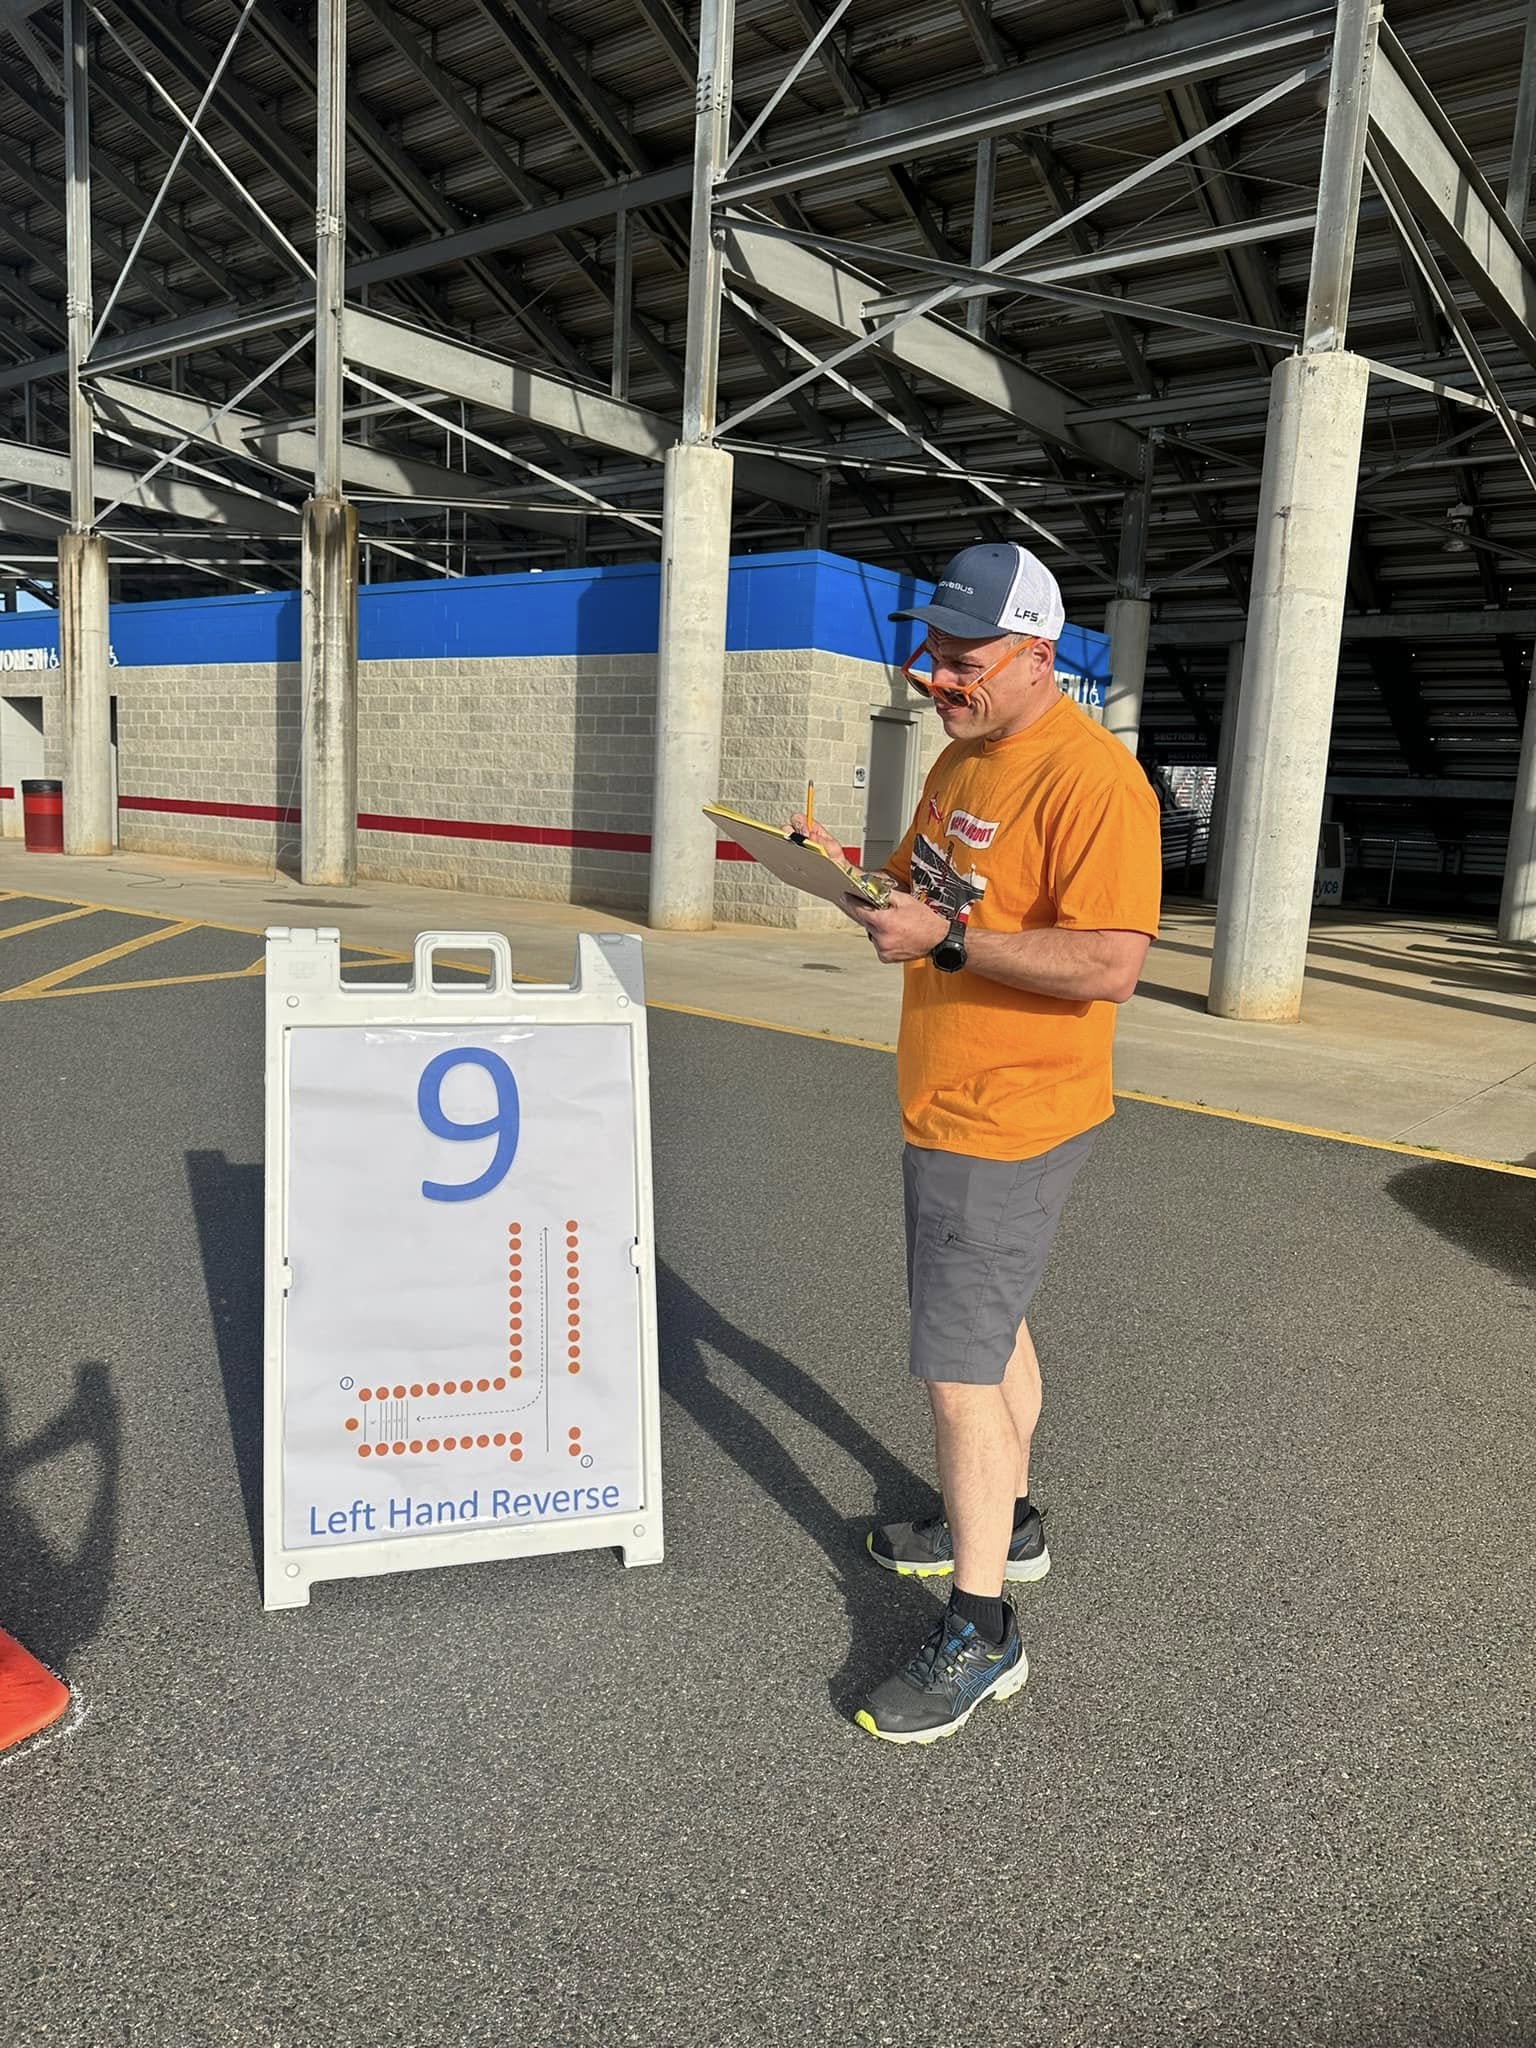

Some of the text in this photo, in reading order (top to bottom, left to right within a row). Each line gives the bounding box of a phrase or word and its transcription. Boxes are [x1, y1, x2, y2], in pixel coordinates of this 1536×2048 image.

[0, 648, 43, 671] OMEN
[417, 1047, 520, 1202] 9
[310, 1484, 620, 1535] Left Hand Reverse
